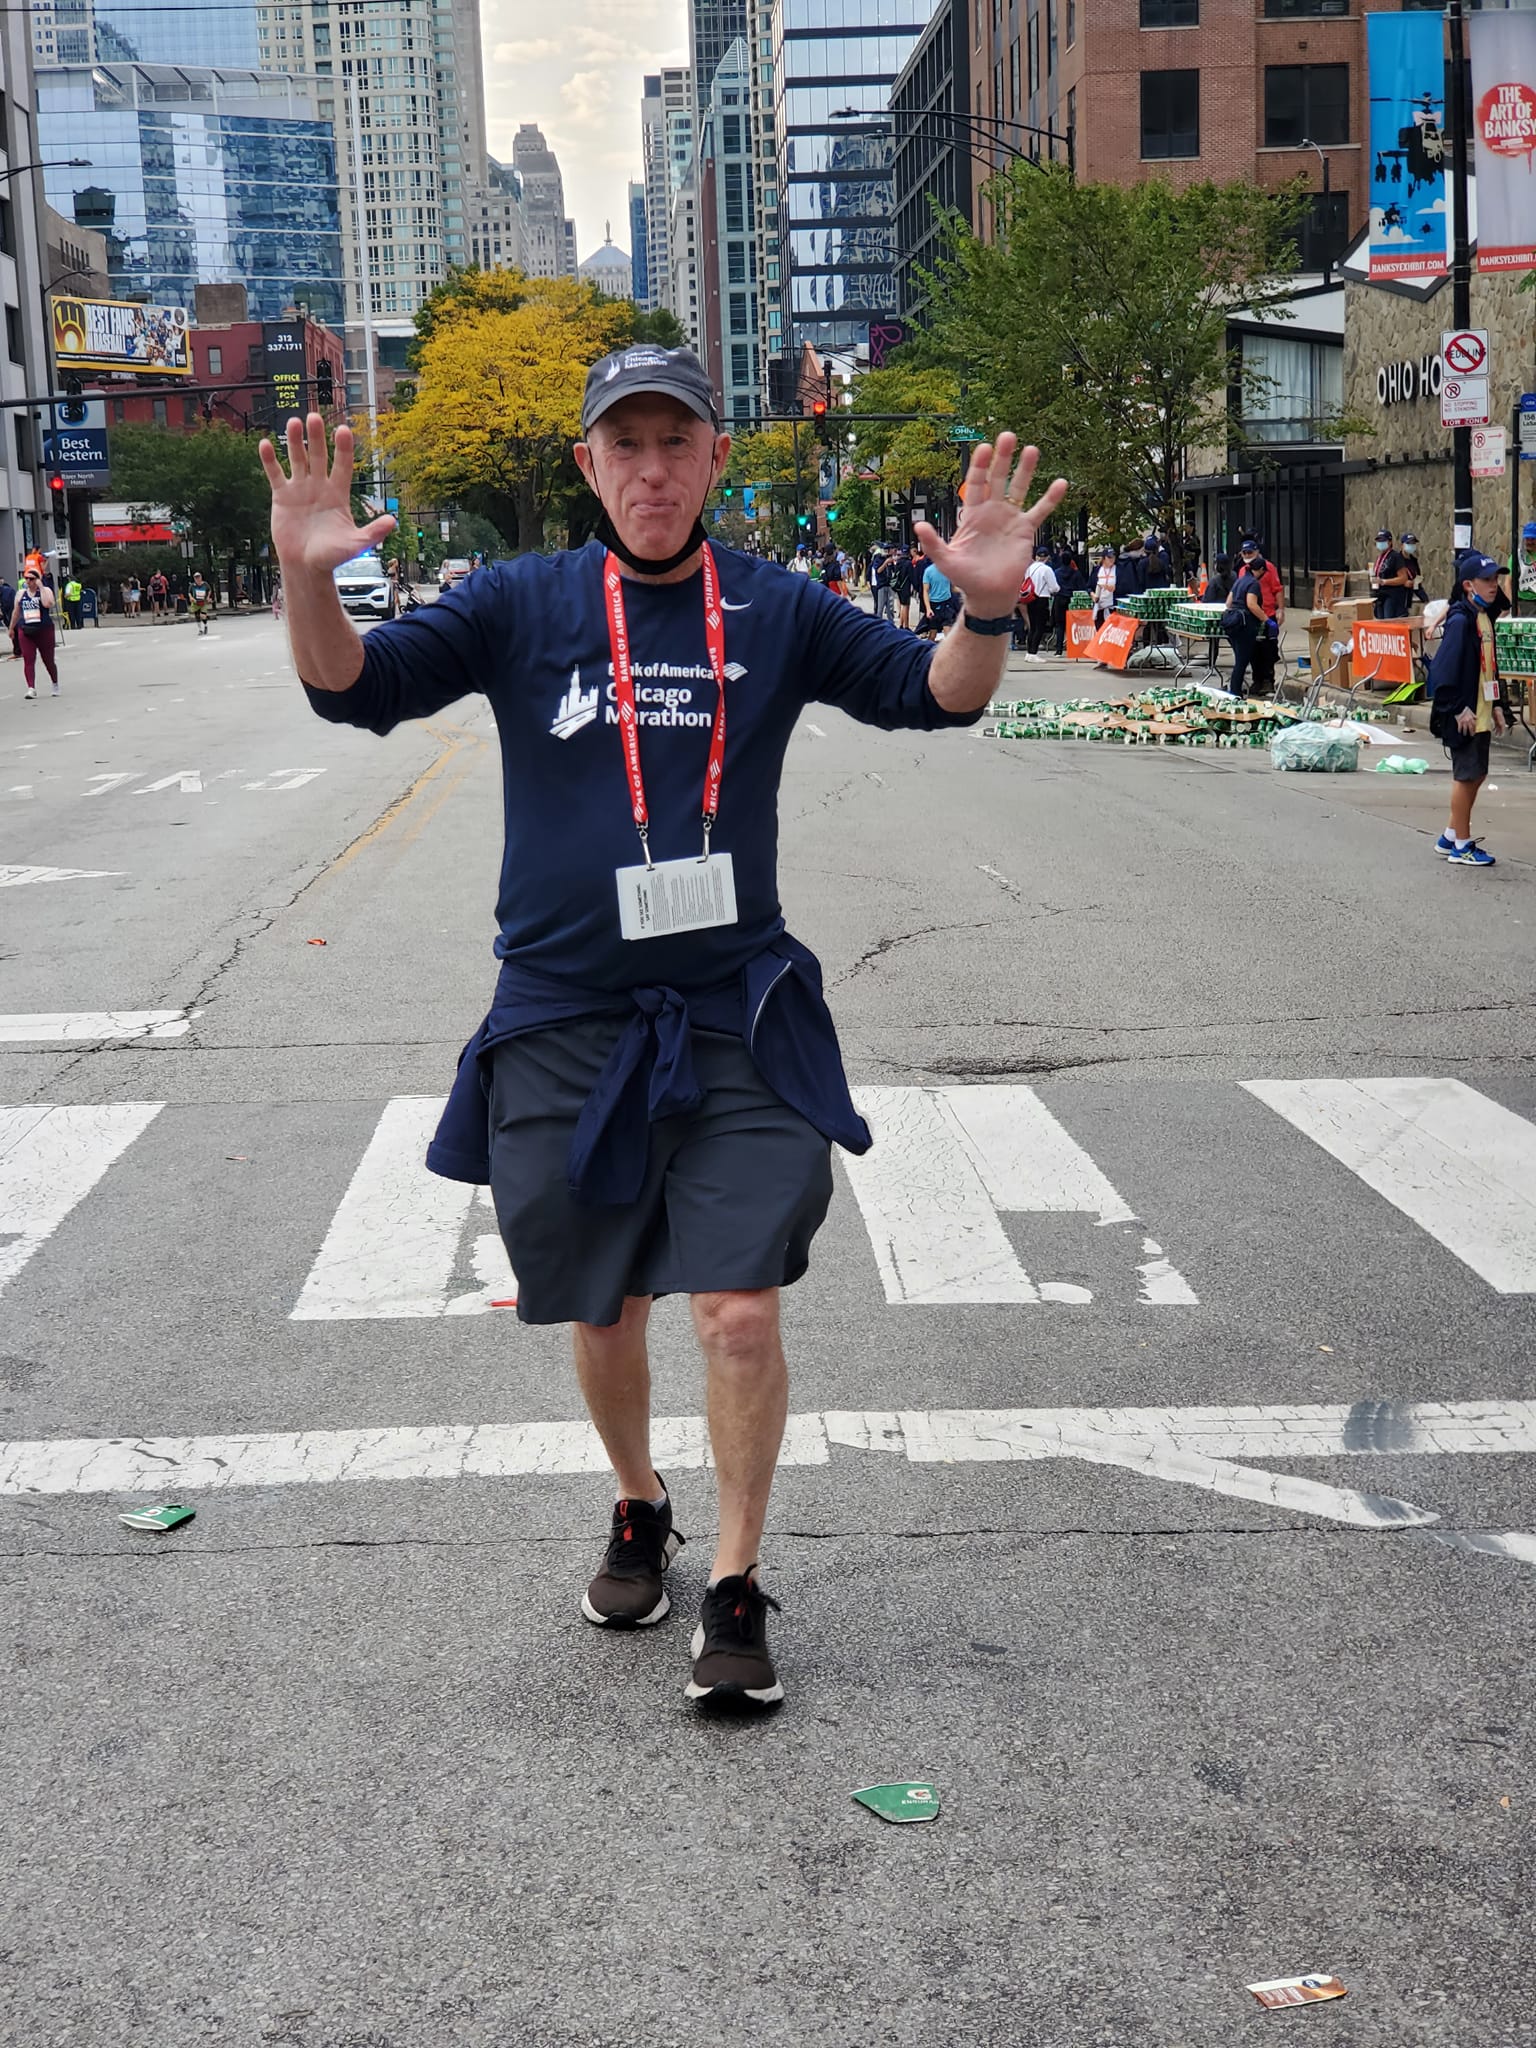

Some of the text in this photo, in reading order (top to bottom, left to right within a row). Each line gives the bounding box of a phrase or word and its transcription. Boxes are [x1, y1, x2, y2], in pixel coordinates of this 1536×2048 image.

[1498, 86, 1522, 103] THE
[1489, 102, 1533, 121] ART OF
[1372, 260, 1445, 274] BANKSYEXHIBIT.COM
[1480, 252, 1536, 266] BANKSYEXHIBIT.
[110, 307, 135, 337] FANS
[94, 332, 126, 354] BASEBALL
[278, 334, 293, 342] 312
[267, 343, 303, 352] 337-1711
[273, 374, 300, 382] OFFICE
[1376, 360, 1413, 405] OHIO
[280, 391, 296, 400] FOR
[61, 438, 91, 450] Best
[77, 473, 95, 481] North
[704, 567, 715, 609] AMERICA
[612, 590, 629, 683] BANK OF AMERICA
[1358, 628, 1407, 658] G ENDURANCE
[608, 662, 715, 680] Bnk of America
[606, 683, 692, 708] Cicago
[605, 704, 712, 727] Mrathon
[626, 723, 639, 772] AMERICA
[633, 774, 641, 788] OF
